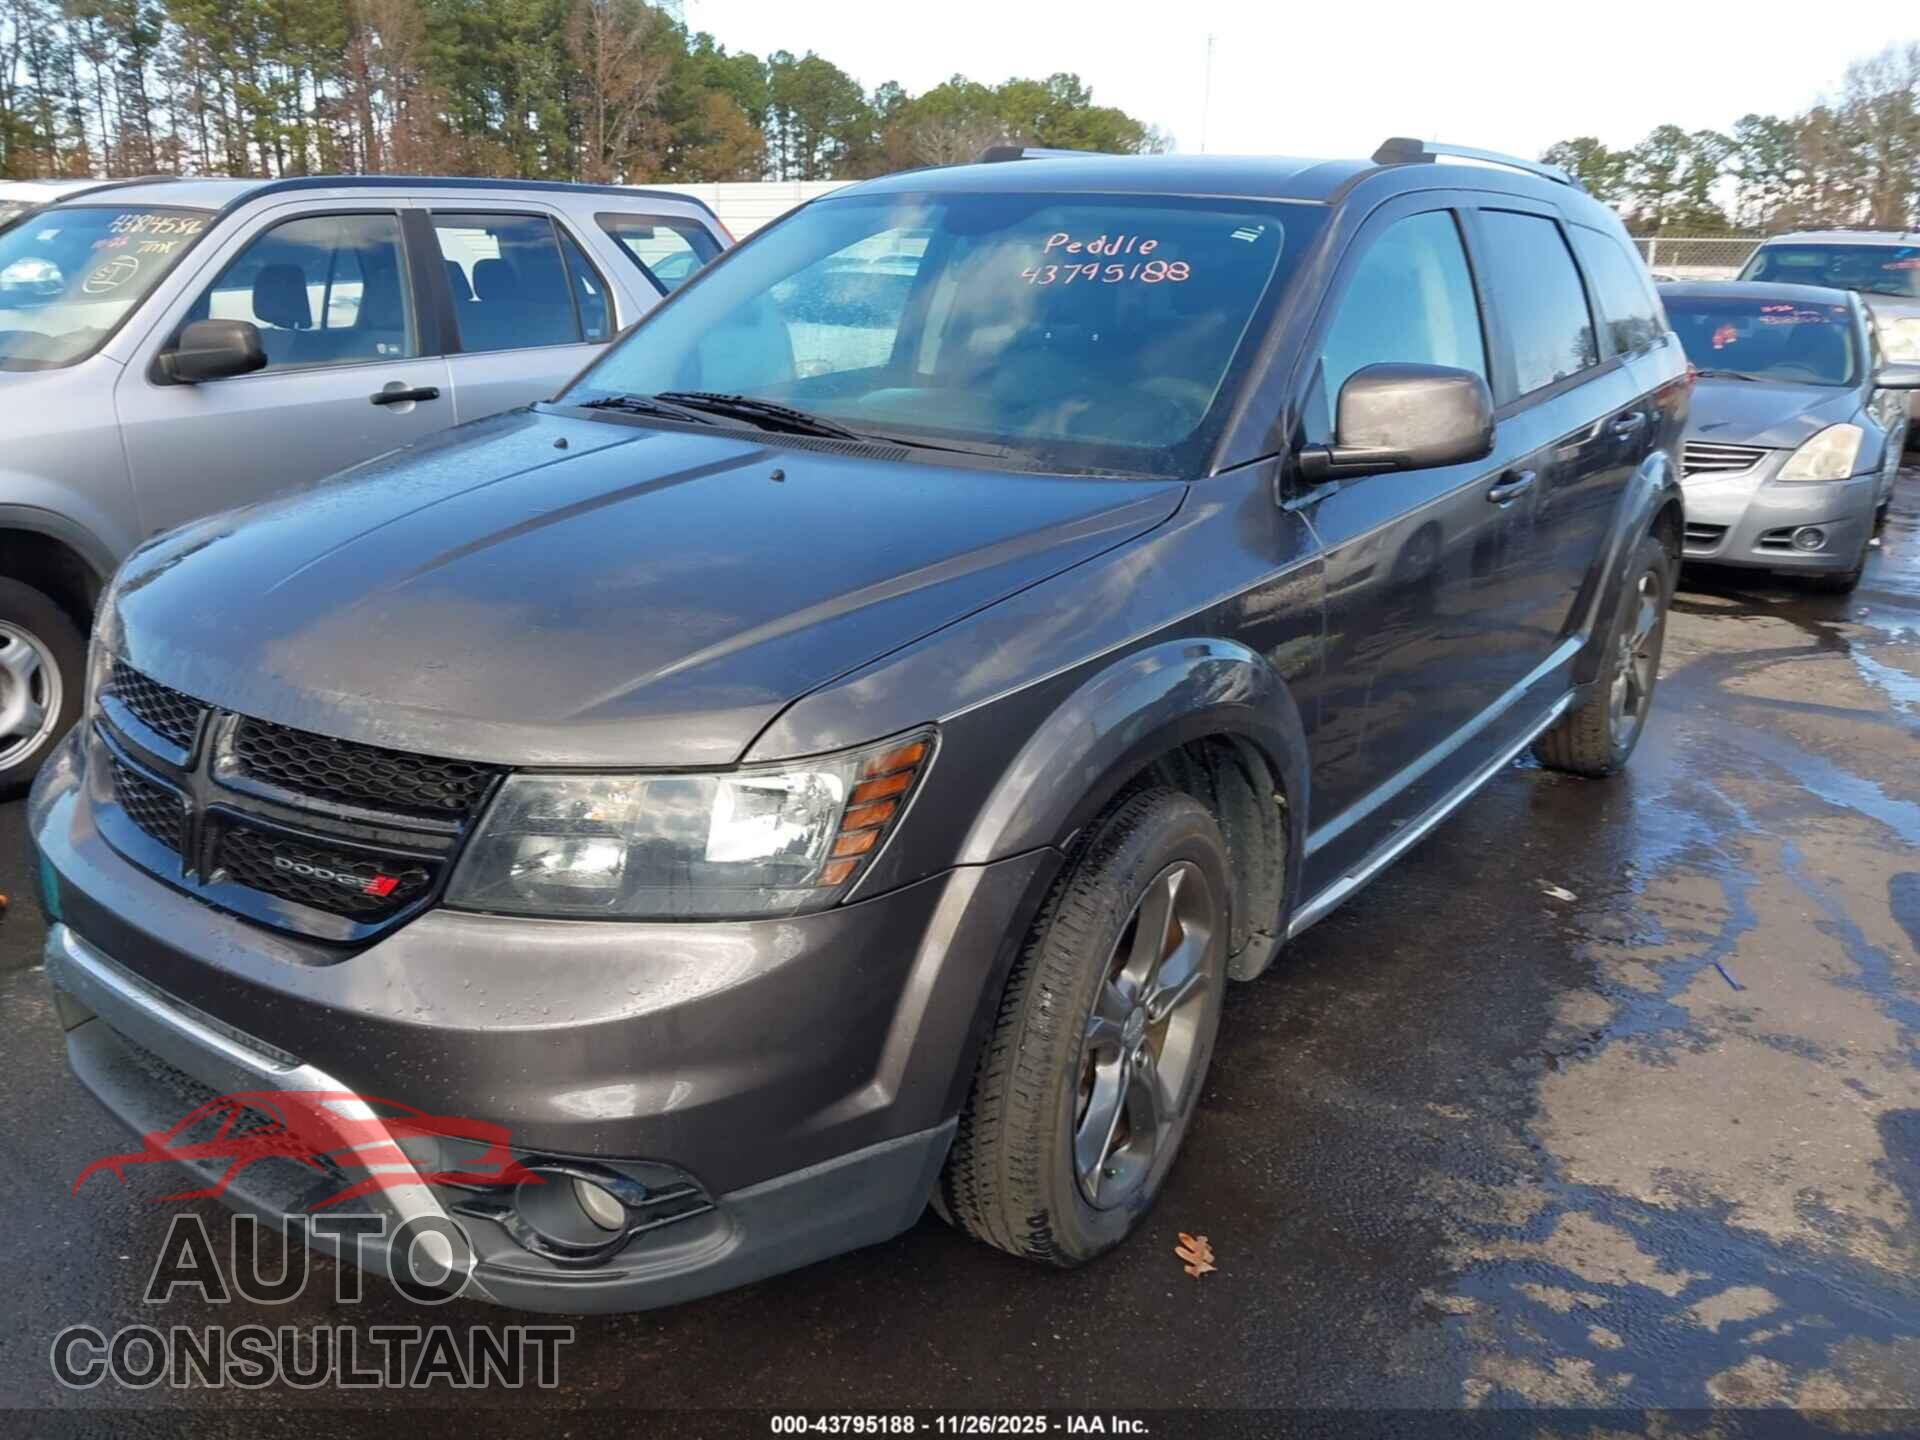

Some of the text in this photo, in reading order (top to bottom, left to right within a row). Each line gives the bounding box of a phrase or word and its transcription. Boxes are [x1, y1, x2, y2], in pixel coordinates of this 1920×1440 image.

[1043, 232, 1160, 256] Peddle
[1020, 260, 1191, 285] 43795188
[274, 856, 379, 891] DODGE
